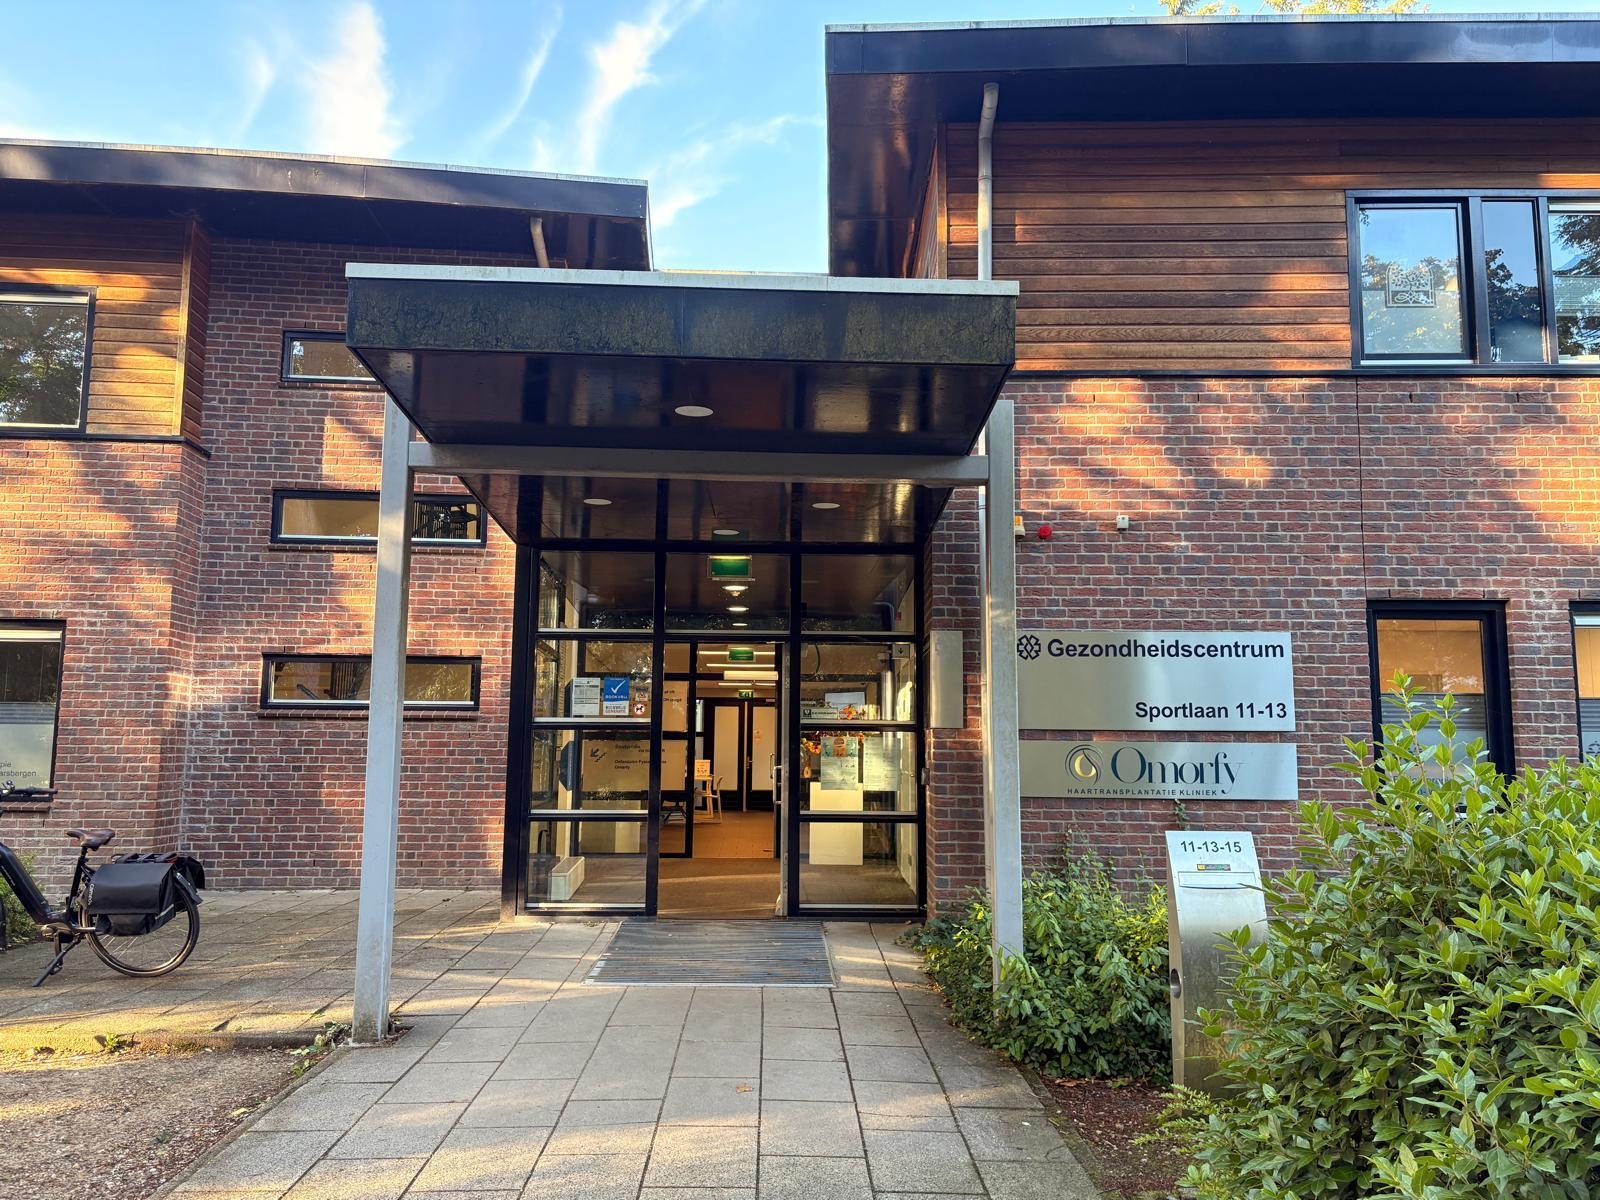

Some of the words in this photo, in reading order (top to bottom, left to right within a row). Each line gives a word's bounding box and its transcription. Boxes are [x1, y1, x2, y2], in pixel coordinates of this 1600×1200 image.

[1047, 638, 1285, 658] Gezondheidscentrum
[1135, 701, 1229, 722] Sportlaan
[1235, 702, 1288, 719] 11-13
[1110, 746, 1248, 795] Omorfy
[1180, 840, 1242, 853] 11-13-15
